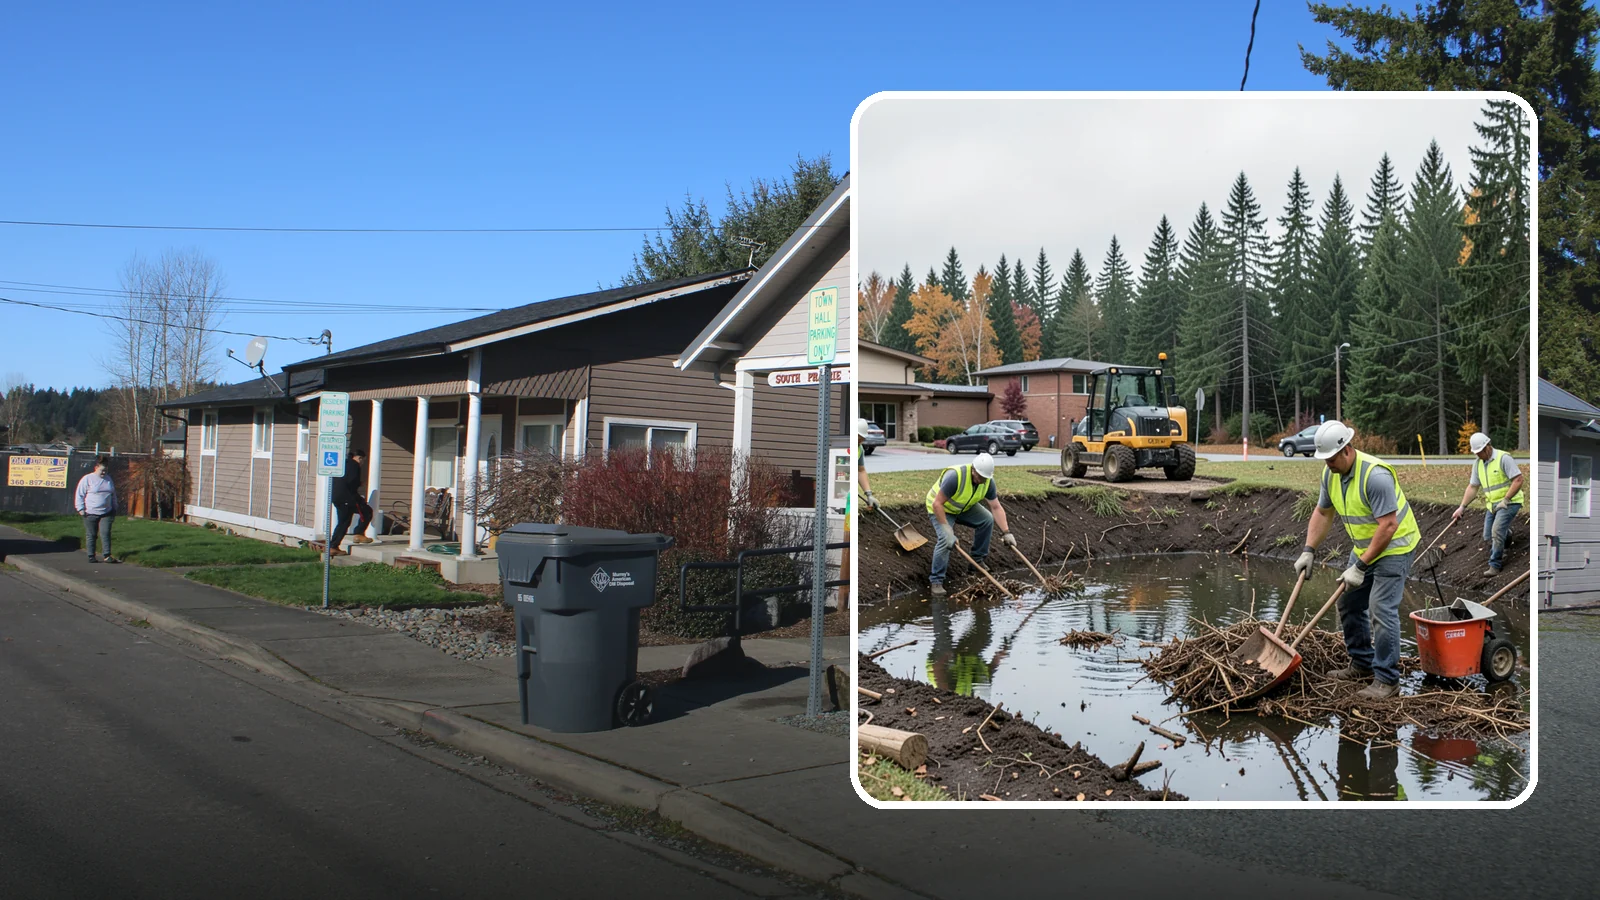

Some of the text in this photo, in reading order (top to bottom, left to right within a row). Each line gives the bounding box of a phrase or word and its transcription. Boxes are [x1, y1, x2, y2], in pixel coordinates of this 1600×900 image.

[815, 294, 832, 307] TOWN
[814, 311, 831, 324] HALL
[810, 326, 836, 341] PARKING
[814, 344, 831, 357] ONLY
[775, 373, 801, 384] SOUTH
[322, 409, 345, 417] PARKING
[325, 420, 340, 428] ONLY
